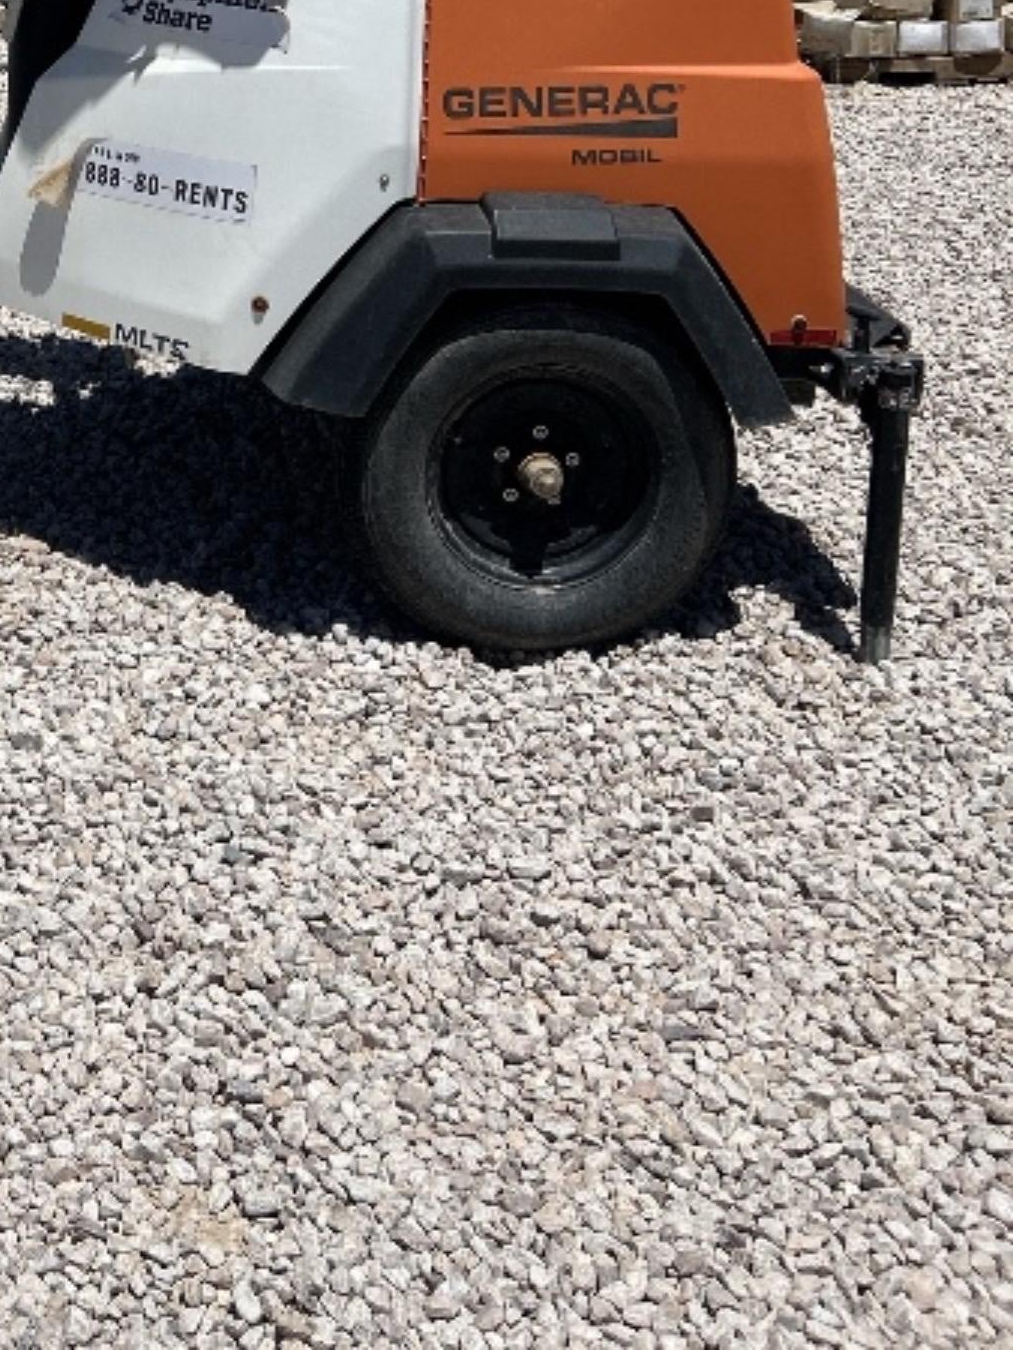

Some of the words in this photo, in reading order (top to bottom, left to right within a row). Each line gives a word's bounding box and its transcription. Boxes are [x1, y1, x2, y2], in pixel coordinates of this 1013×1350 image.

[143, 0, 213, 31] Share
[442, 84, 679, 118] GENERAC
[571, 149, 662, 165] MOBIL
